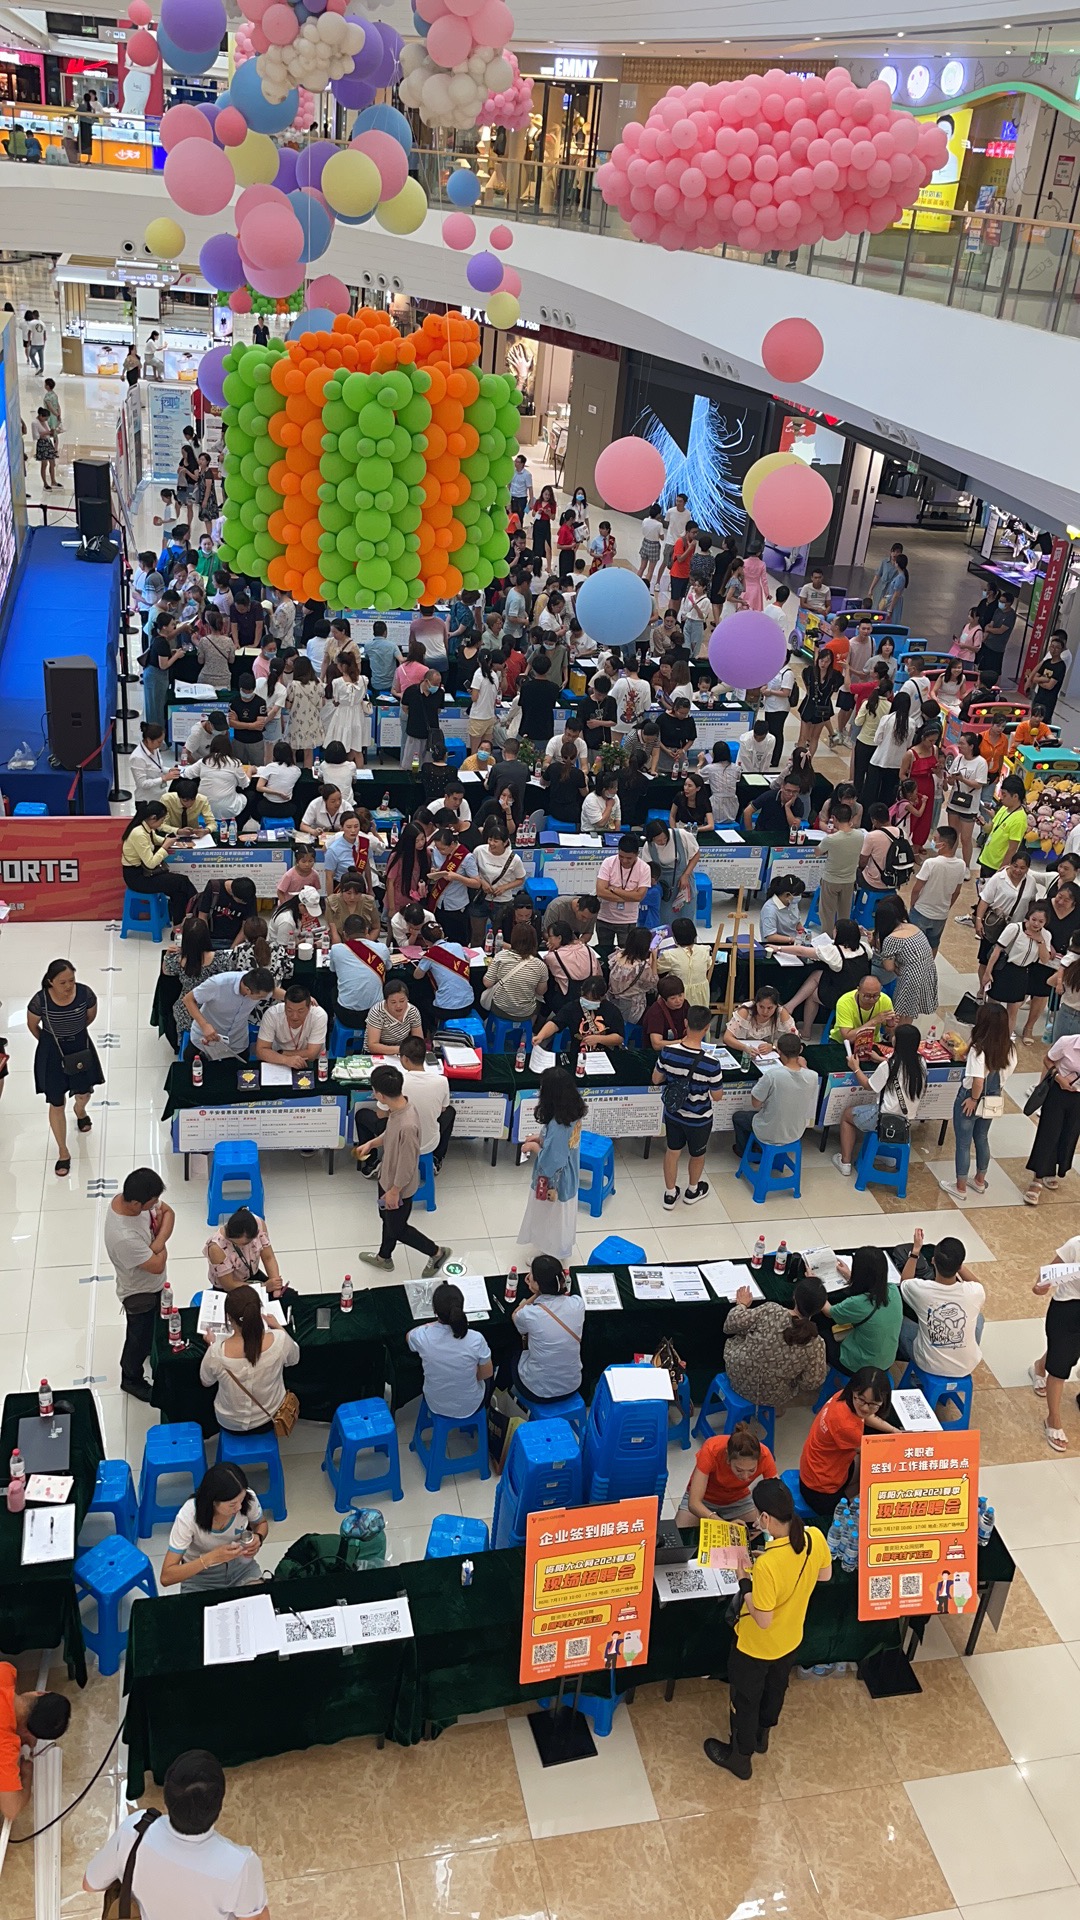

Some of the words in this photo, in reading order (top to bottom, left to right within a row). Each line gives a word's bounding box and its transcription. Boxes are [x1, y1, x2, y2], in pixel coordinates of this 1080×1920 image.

[554, 58, 598, 78] EMMY
[1030, 538, 1064, 657] 网上街上苏宁
[0, 859, 79, 883] ORTS
[904, 1447, 935, 1457] 求职者
[877, 1486, 961, 1500] 资阳大众网2021夏季
[876, 1498, 962, 1520] 现场招聘会
[538, 1518, 646, 1547] 企业签到服务点
[545, 1552, 636, 1574] 资阳大众网2021夏季
[542, 1564, 637, 1592] 现场招聘会
